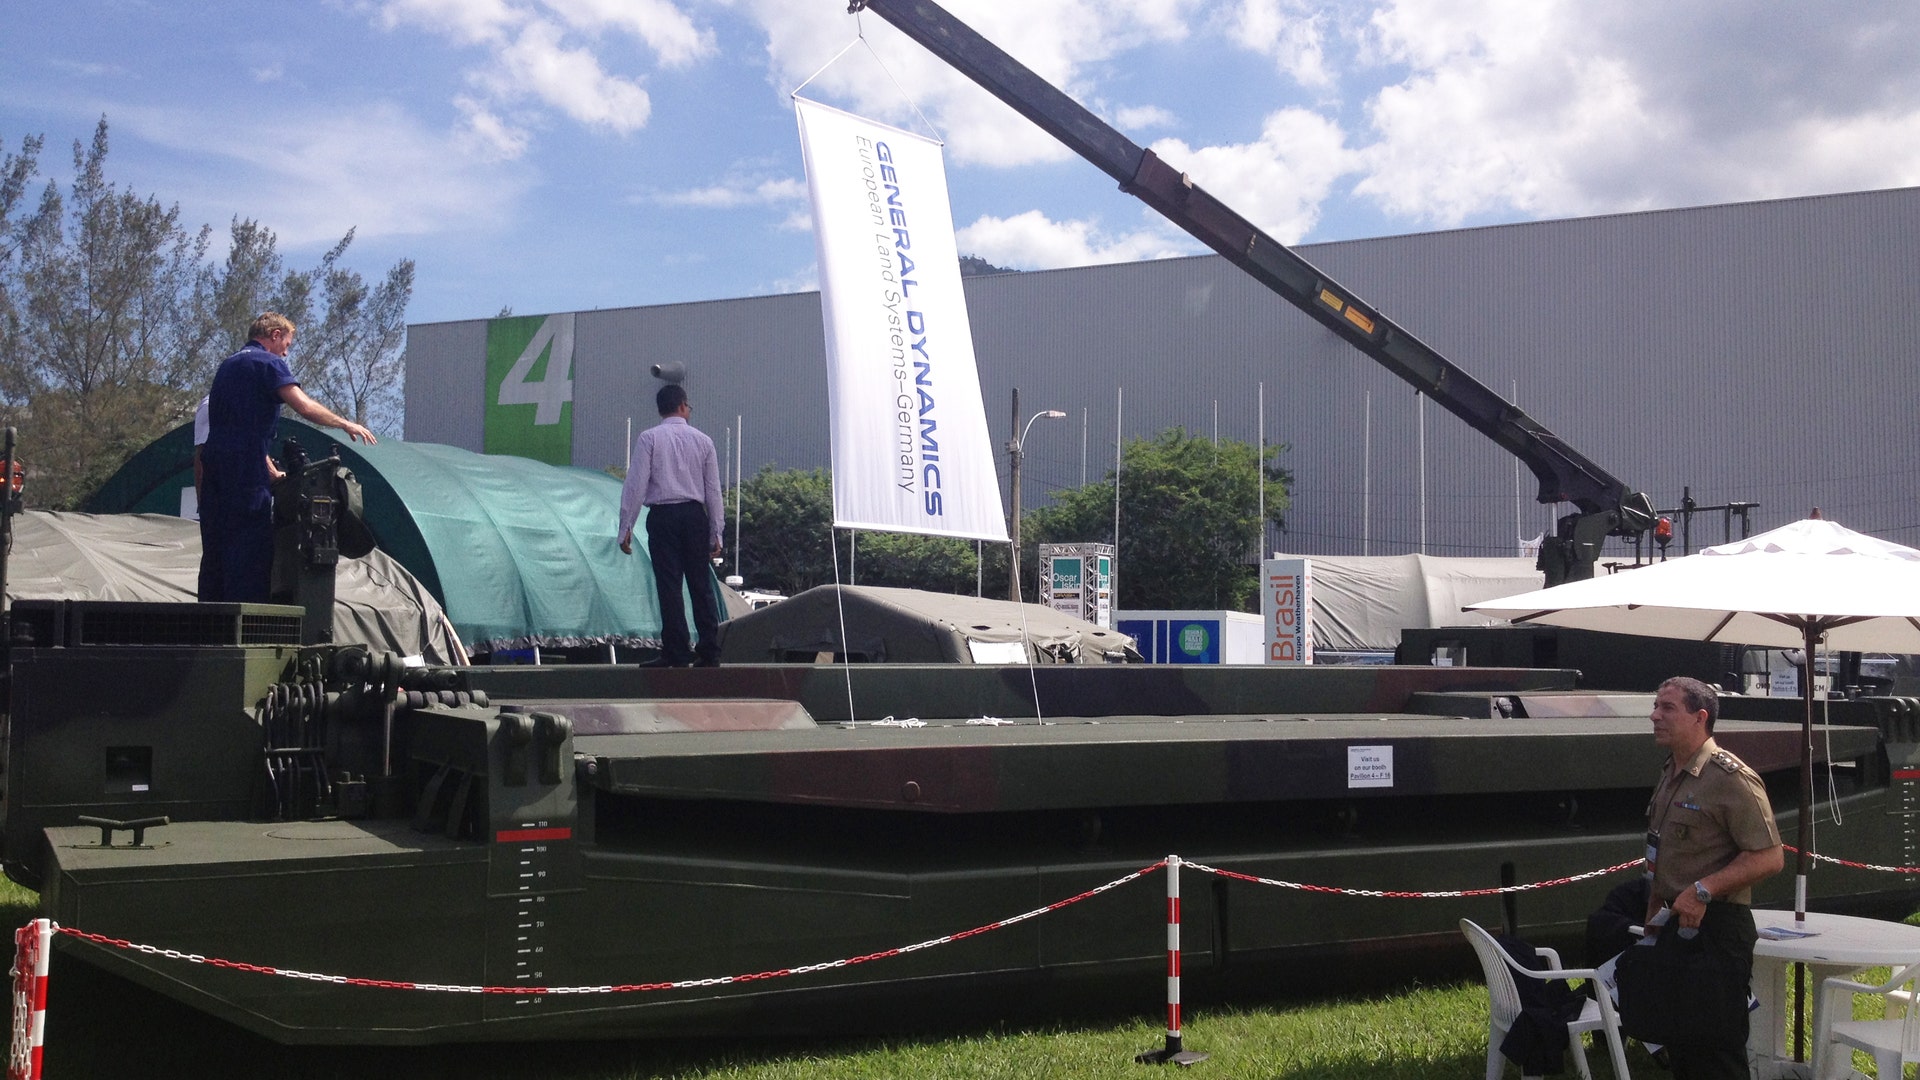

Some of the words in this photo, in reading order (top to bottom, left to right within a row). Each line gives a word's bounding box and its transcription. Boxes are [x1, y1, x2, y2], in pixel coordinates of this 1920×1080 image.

[856, 135, 884, 226] European
[876, 233, 898, 284] Land
[498, 313, 575, 425] 4
[876, 141, 918, 298] GENERAL
[906, 310, 943, 516] DYNAMICS
[1053, 572, 1077, 582] Oscar
[1270, 576, 1294, 661] Brasil
